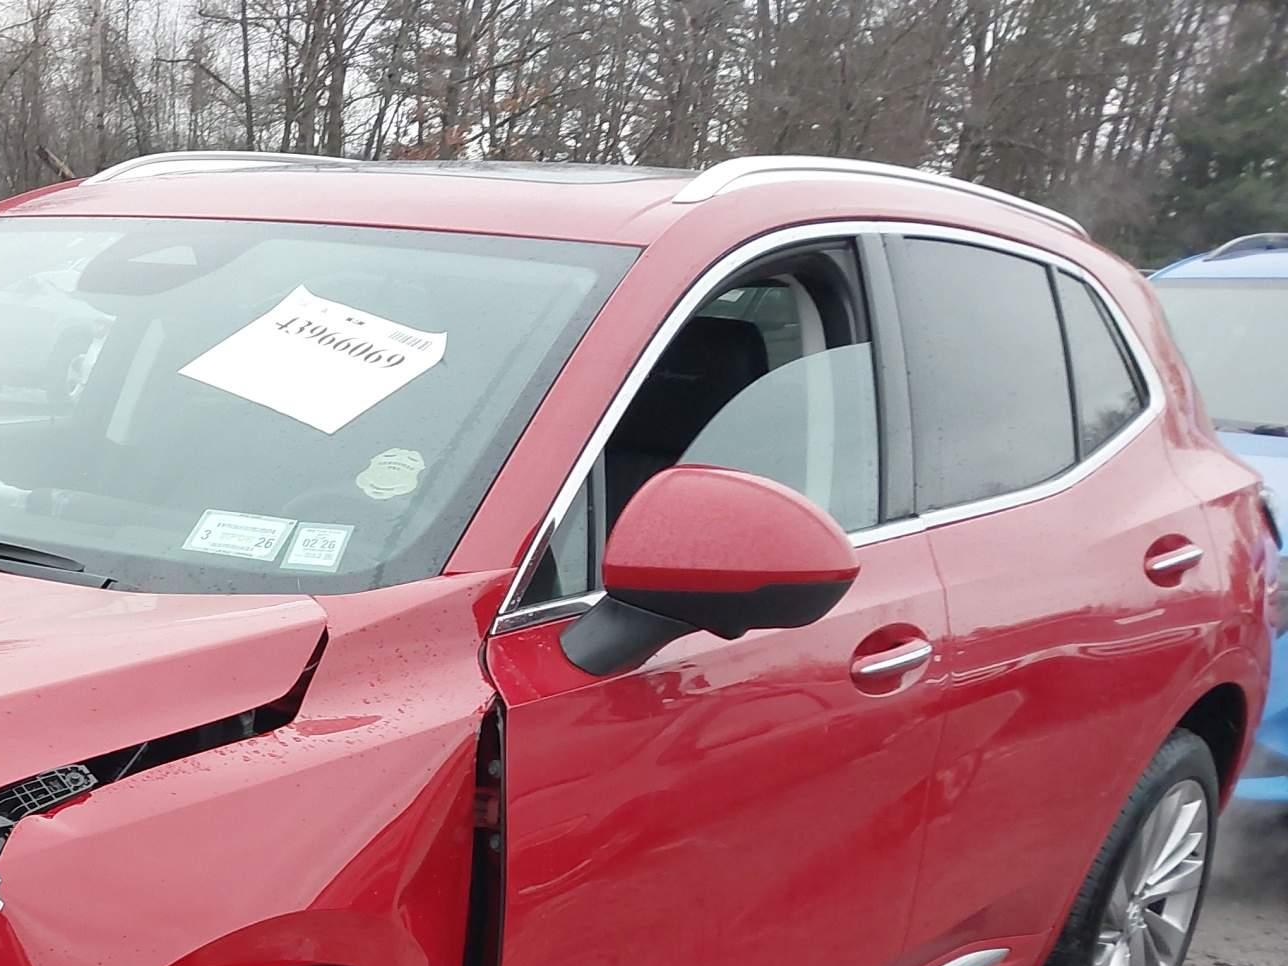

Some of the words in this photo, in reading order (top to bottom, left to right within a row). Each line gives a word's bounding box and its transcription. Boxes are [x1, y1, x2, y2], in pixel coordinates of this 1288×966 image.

[275, 316, 406, 369] 43966069
[200, 529, 212, 541] 3
[253, 536, 276, 549] 26
